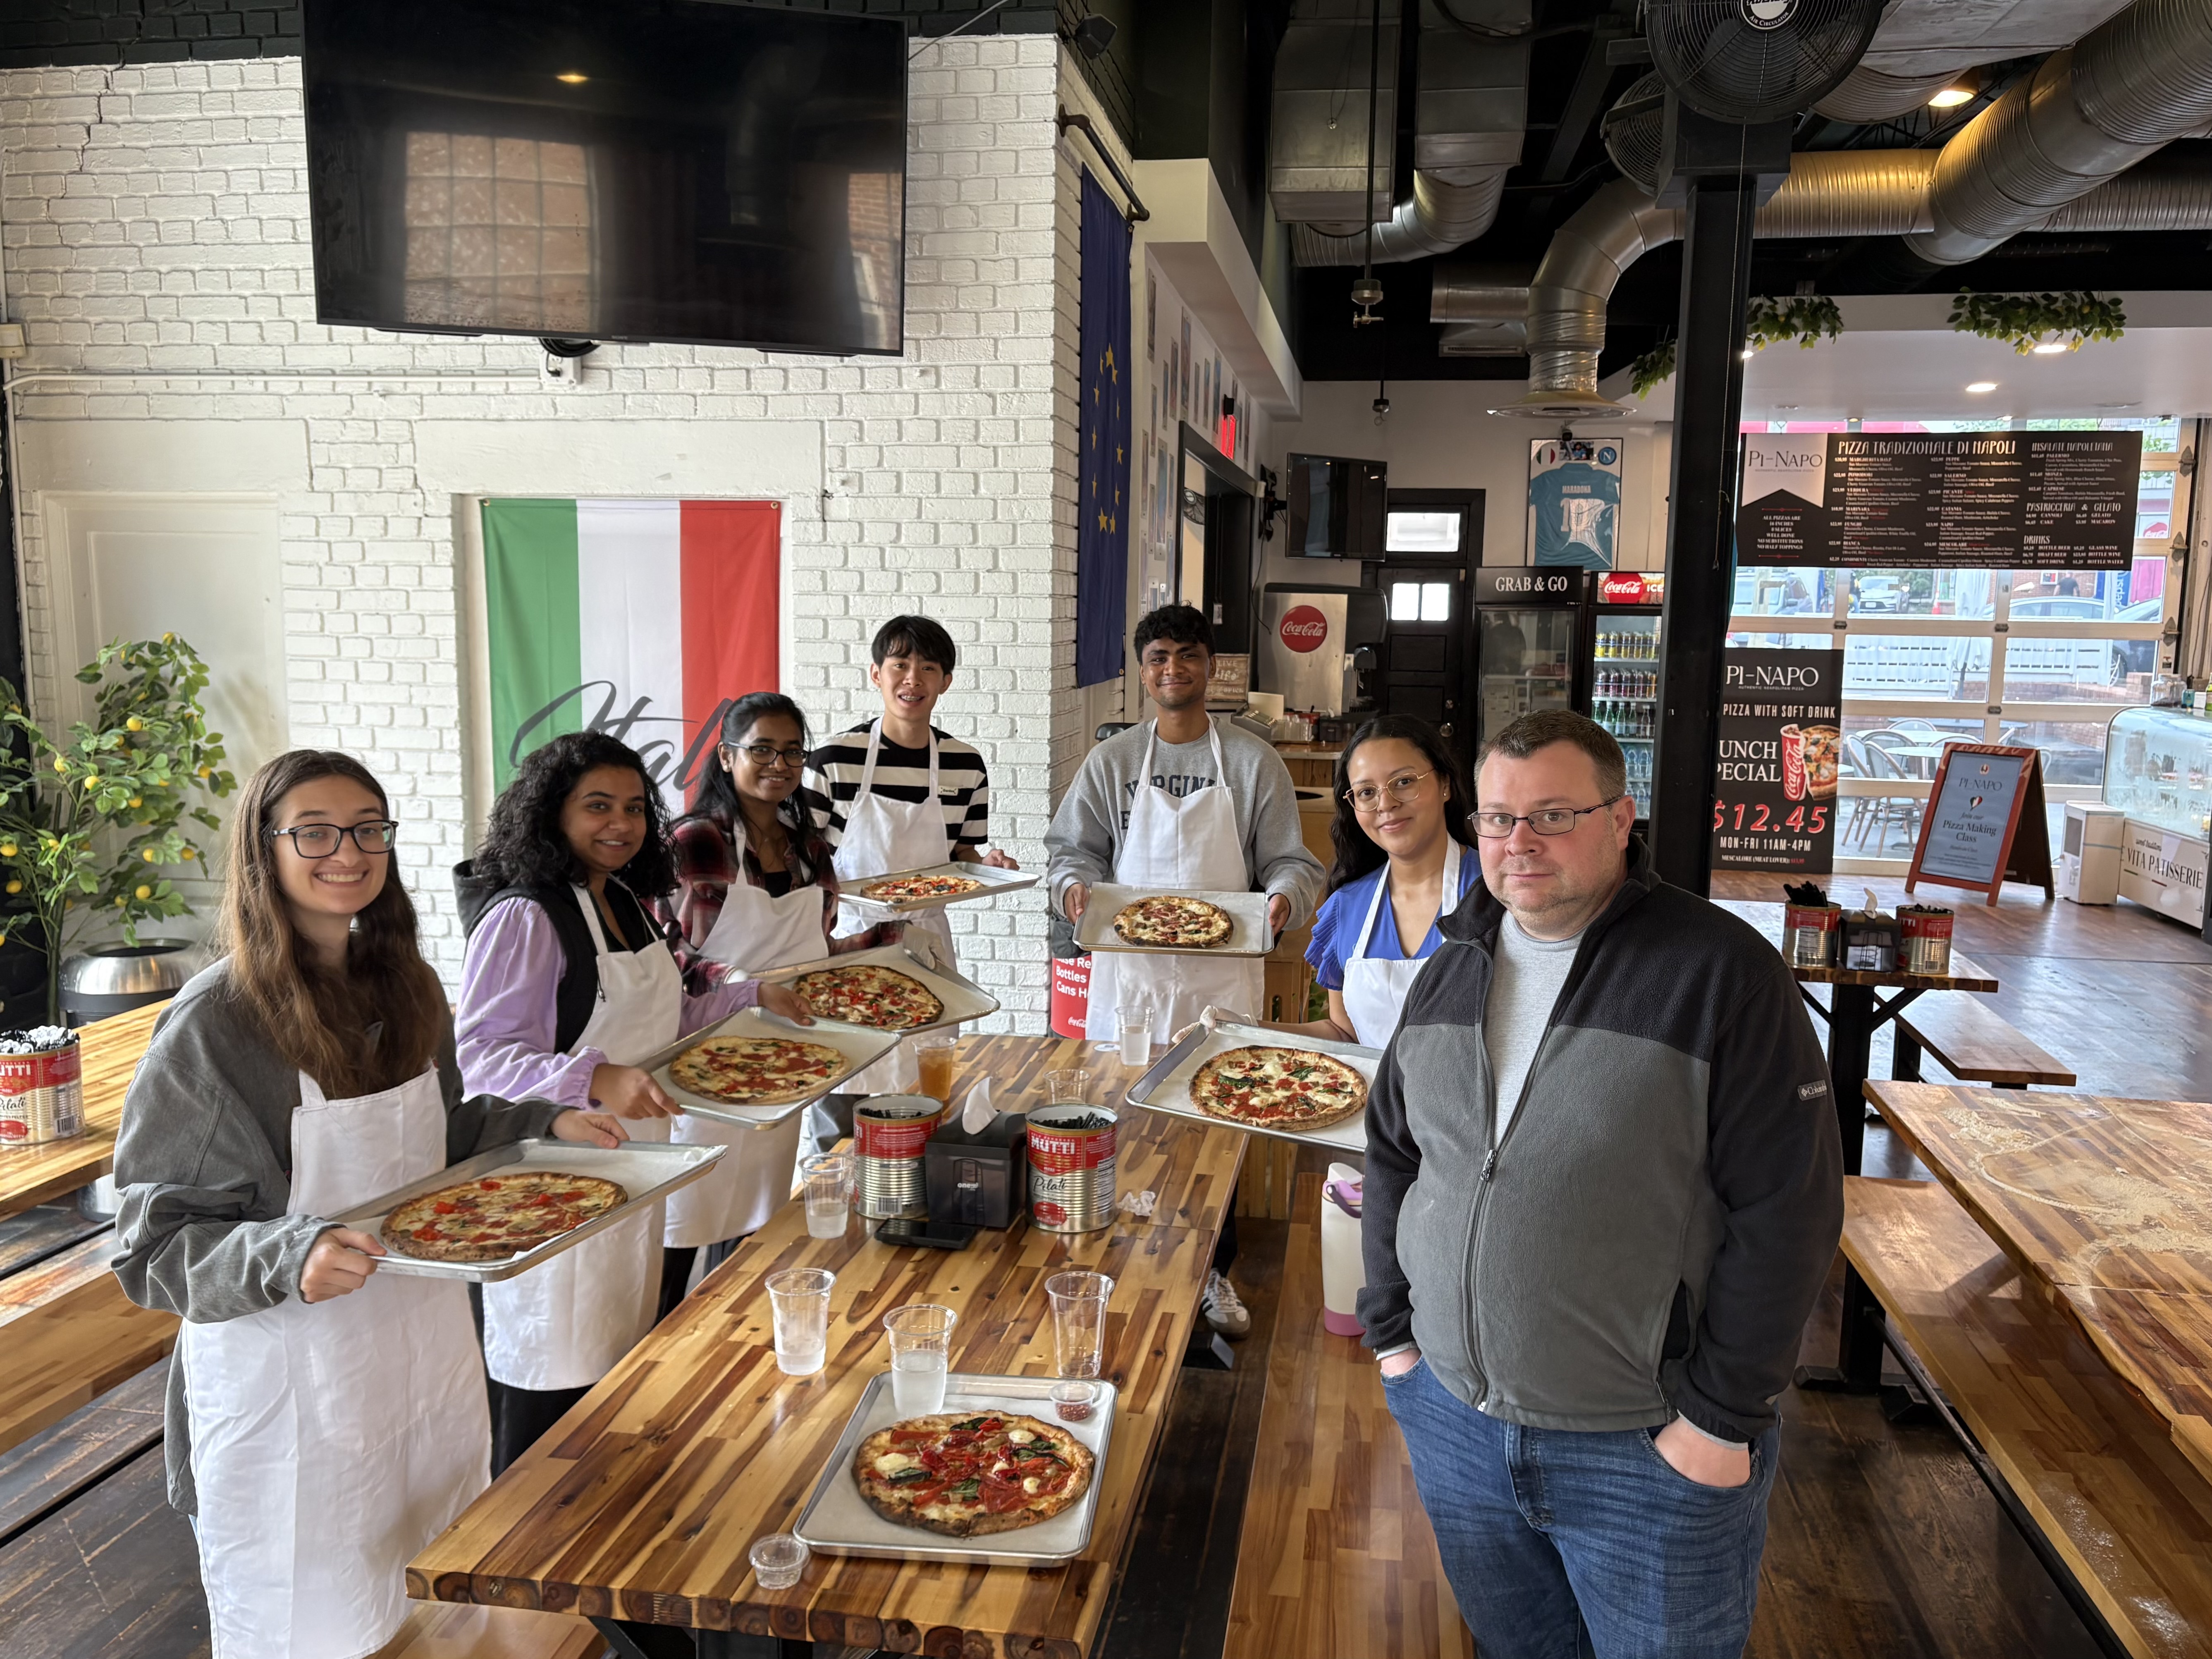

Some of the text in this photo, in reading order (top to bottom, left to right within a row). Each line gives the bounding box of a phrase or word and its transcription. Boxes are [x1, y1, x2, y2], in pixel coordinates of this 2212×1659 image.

[1749, 12, 1789, 26] AIR CIRCULATOR
[1838, 440, 2016, 454] PIZZA TRADIZIONALE DI NAPOLI
[1562, 485, 1591, 494] MARADONA
[2023, 535, 2050, 544] DRINKS
[1495, 577, 1568, 592] GRAB & GO
[1646, 584, 1664, 592] ICE
[1726, 665, 1819, 687] PI-NAPO
[1723, 704, 1835, 718] PIZZA WITH SOFT DRINK
[1719, 740, 1778, 759] UNCH
[1718, 763, 1781, 782] ECIAL
[1959, 777, 2002, 791] PI-NAPO
[1713, 800, 1828, 834] $12.45
[1943, 820, 1997, 836] Pizza Making
[1720, 837, 1811, 851] MON-FRI 11AM-4PM
[1956, 832, 1976, 843] Class
[2128, 848, 2203, 889] VITA PATISSERIE
[1056, 966, 1087, 983] Bottles
[1057, 981, 1076, 997] Cans
[0, 1064, 31, 1076] UTTI
[1031, 1135, 1075, 1155] MUTTI
[1033, 1176, 1066, 1192] Pelati
